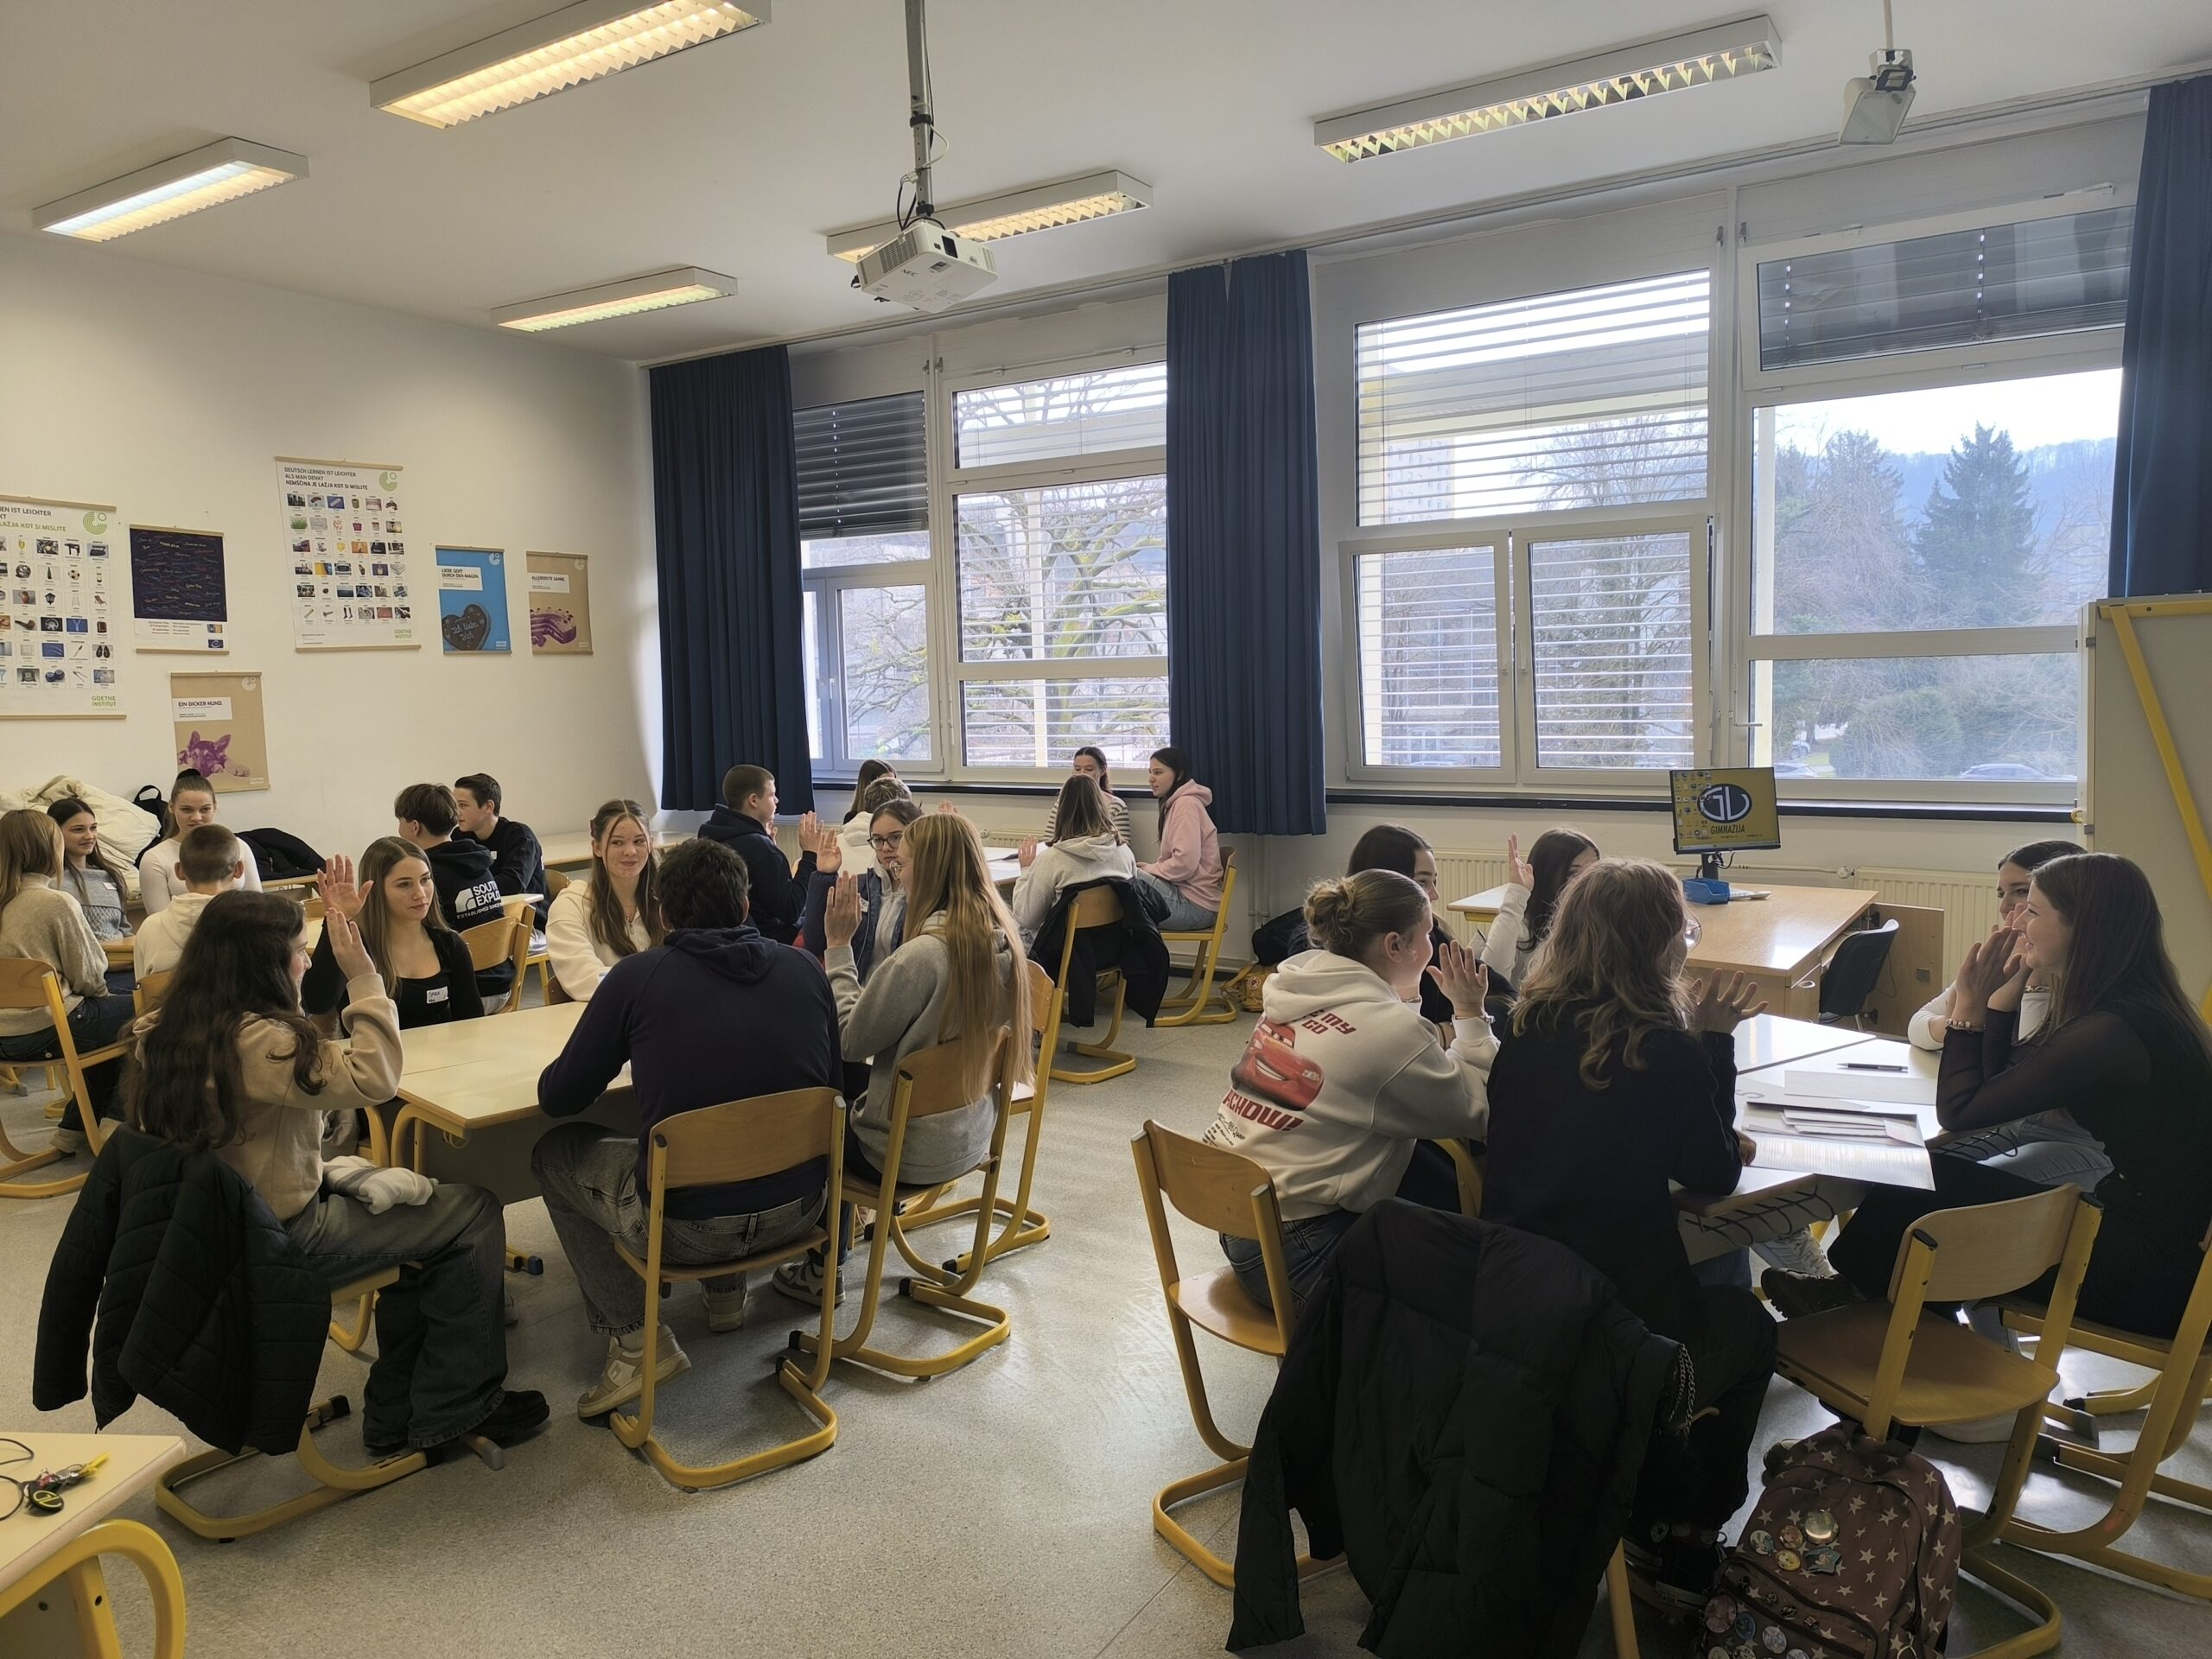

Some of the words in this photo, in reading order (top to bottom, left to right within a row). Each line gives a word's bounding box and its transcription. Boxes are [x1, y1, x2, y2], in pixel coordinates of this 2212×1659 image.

[22, 508, 52, 517] LEICHTER
[1711, 823, 1745, 835] GIMNAZIJA
[456, 906, 489, 919] ESTABLISHED
